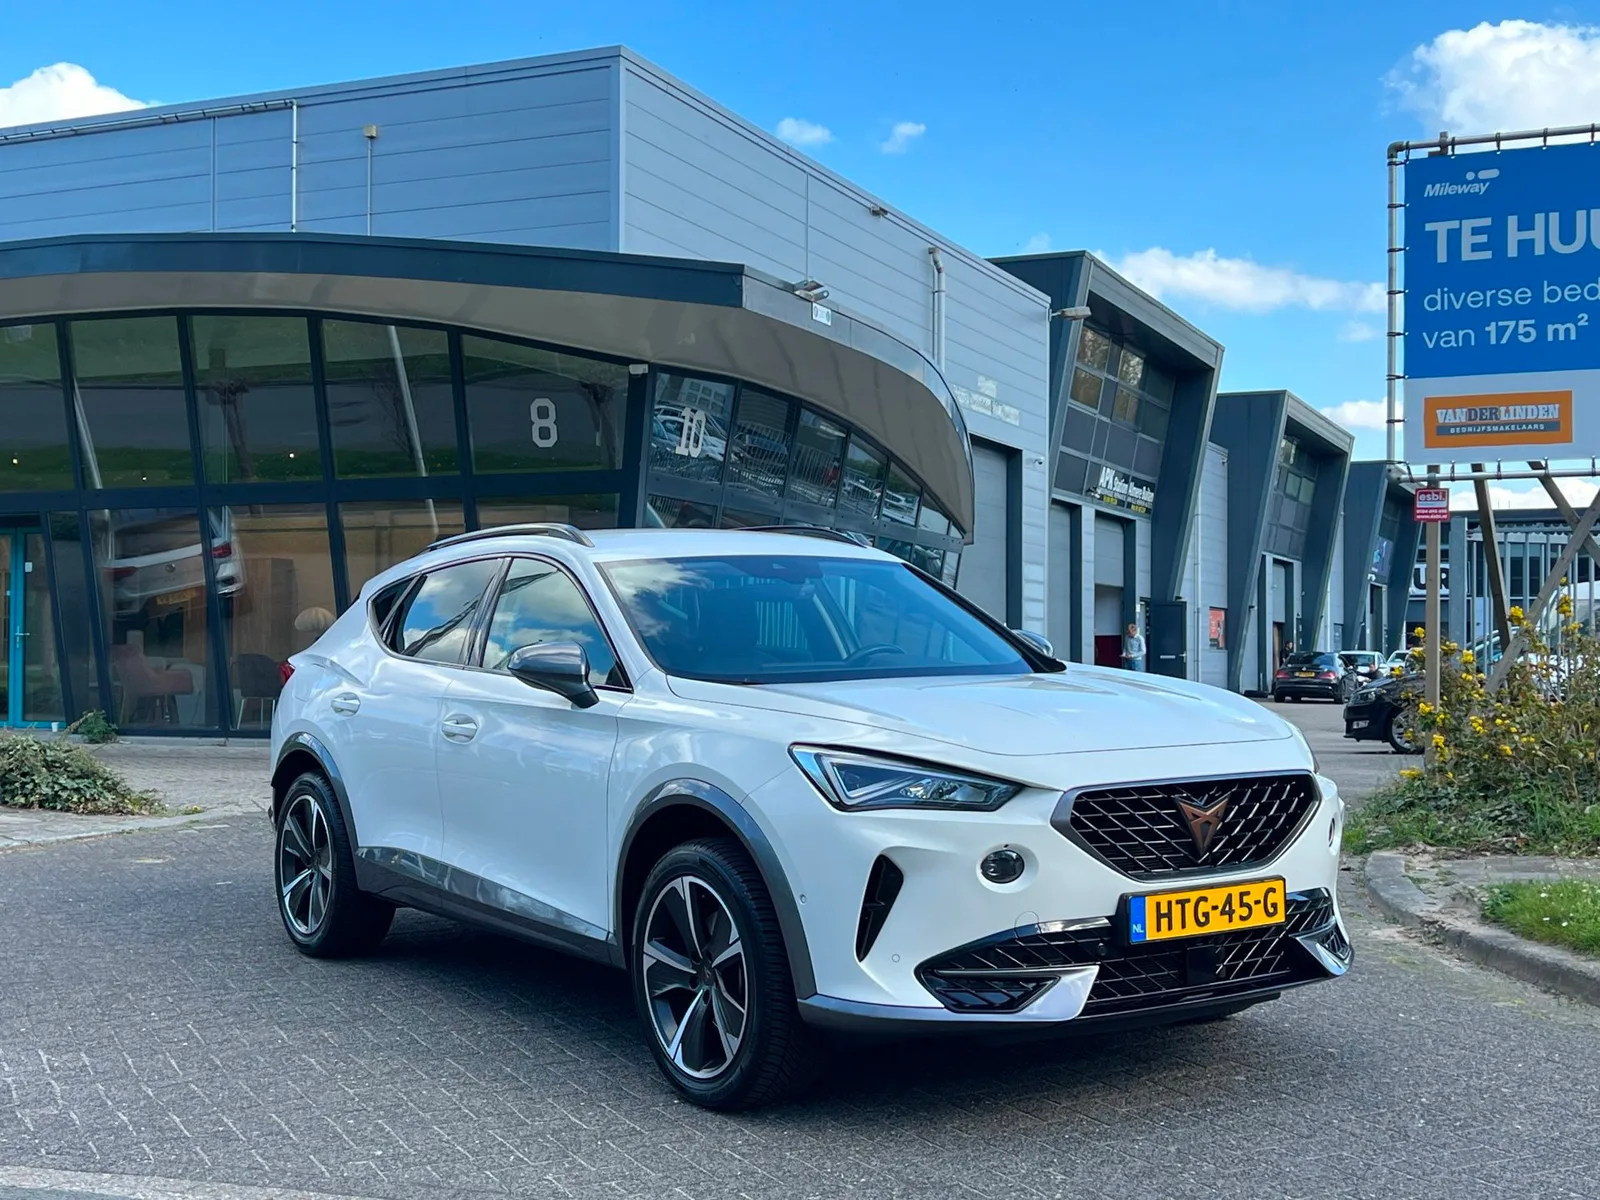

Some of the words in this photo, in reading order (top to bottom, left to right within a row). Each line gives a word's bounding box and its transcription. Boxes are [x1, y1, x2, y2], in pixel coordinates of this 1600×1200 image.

[1424, 182, 1490, 197] Mileway
[1425, 217, 1492, 263] TE
[1507, 209, 1600, 258] HU
[1424, 287, 1532, 311] diverse
[1543, 277, 1600, 303] bed
[1422, 328, 1476, 349] van
[1485, 319, 1537, 345] 175
[530, 398, 558, 447] 8
[675, 407, 706, 458] 10
[1450, 424, 1545, 434] BEDRIJFSMAKELAARS
[1156, 887, 1278, 932] HTG-45-G
[1132, 923, 1144, 934] NL
